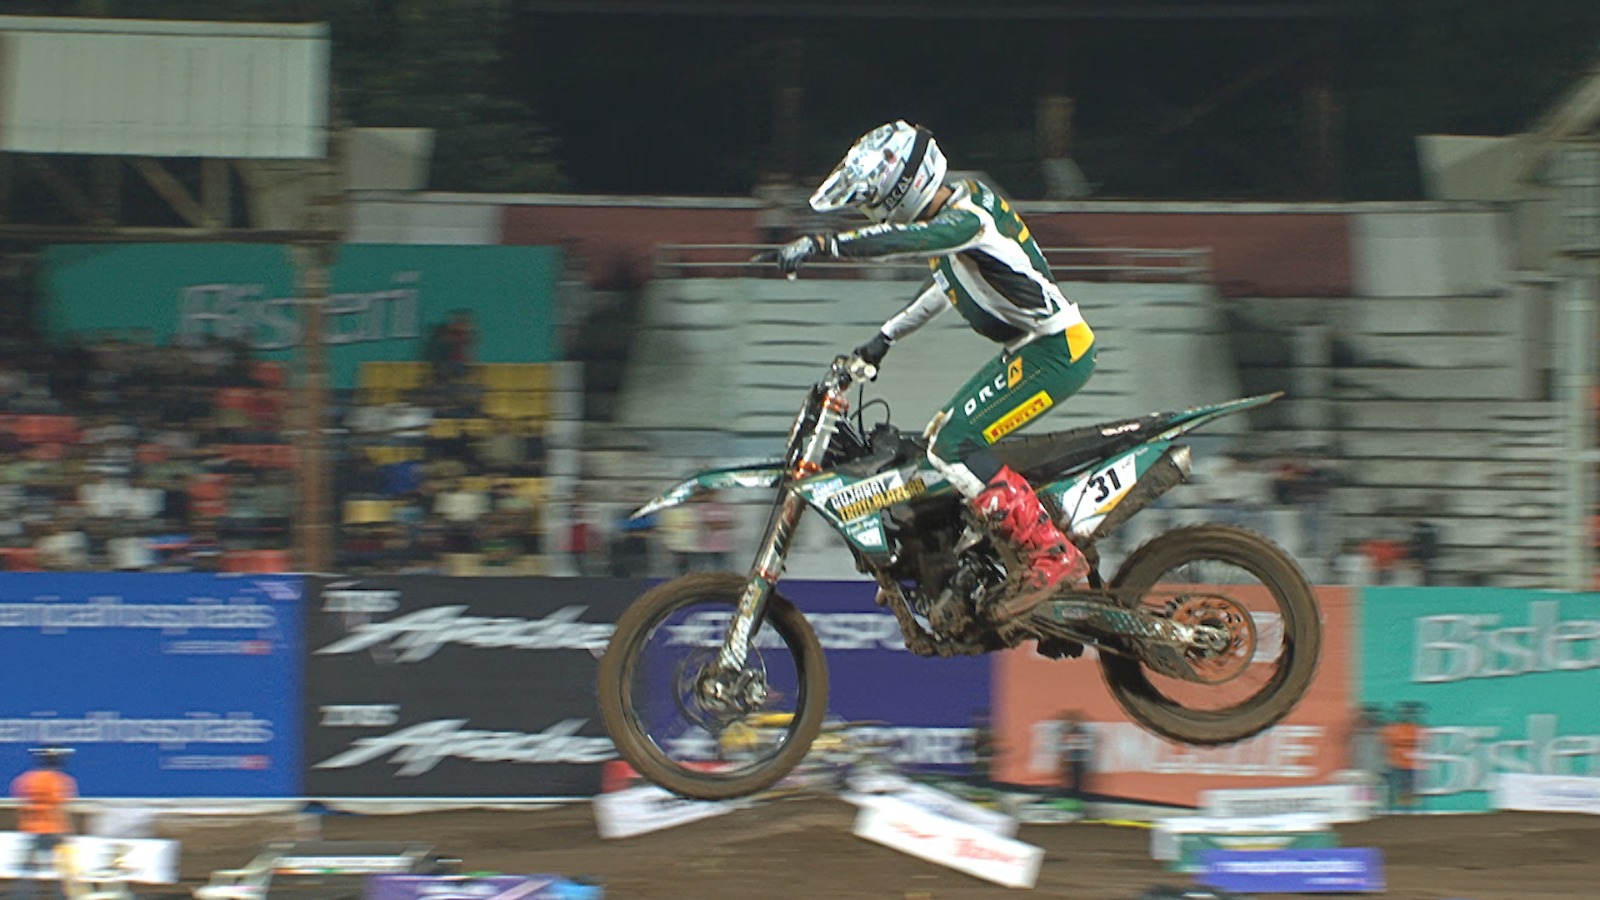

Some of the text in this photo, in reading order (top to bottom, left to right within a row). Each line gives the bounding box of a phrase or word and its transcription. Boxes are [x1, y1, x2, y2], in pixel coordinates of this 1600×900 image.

[179, 270, 420, 351] Biseri
[964, 358, 1022, 416] ORCA
[829, 479, 887, 510] GUJARAT
[1087, 467, 1121, 503] 31
[311, 605, 616, 663] Apache
[310, 718, 620, 777] Apache
